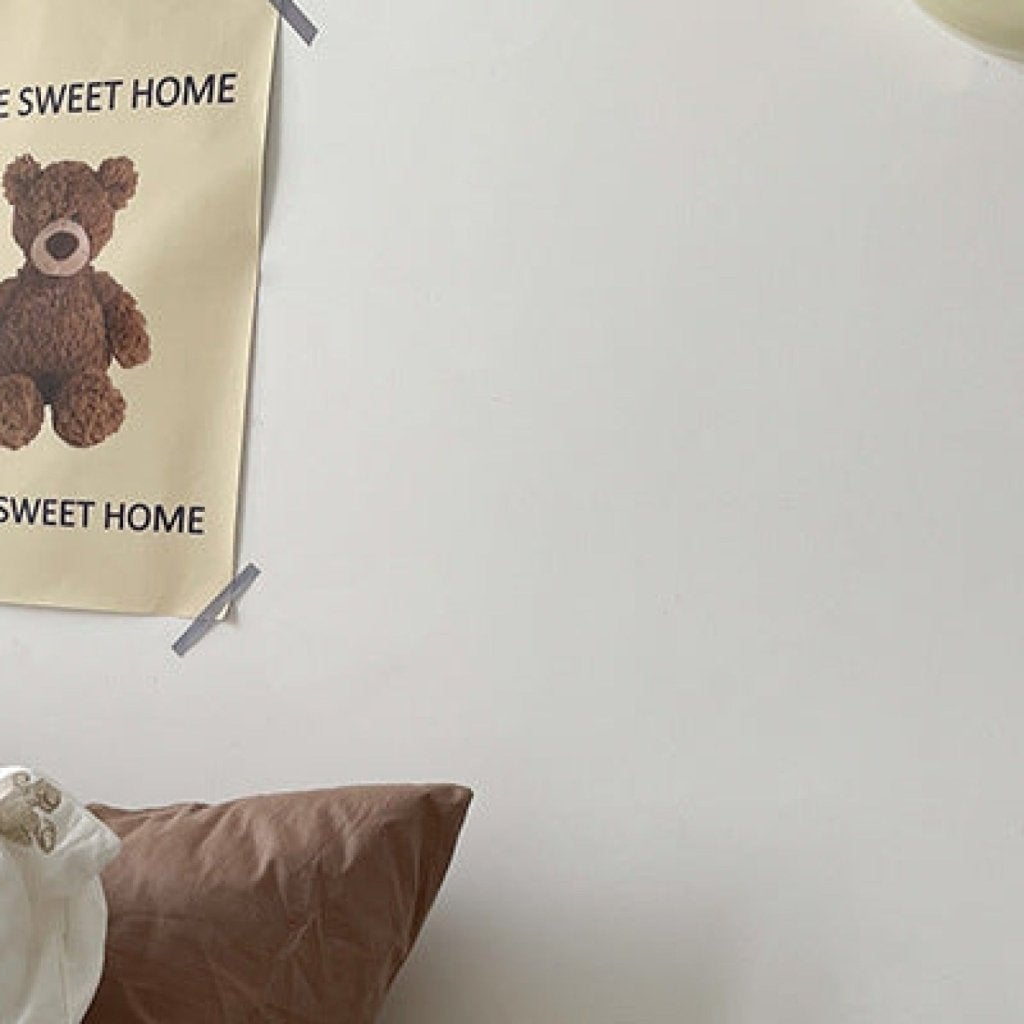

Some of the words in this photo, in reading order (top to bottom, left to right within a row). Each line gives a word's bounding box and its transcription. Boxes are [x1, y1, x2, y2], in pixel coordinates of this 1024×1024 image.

[17, 79, 124, 116] SWEET
[131, 72, 238, 109] HOME
[104, 501, 206, 535] HOME
